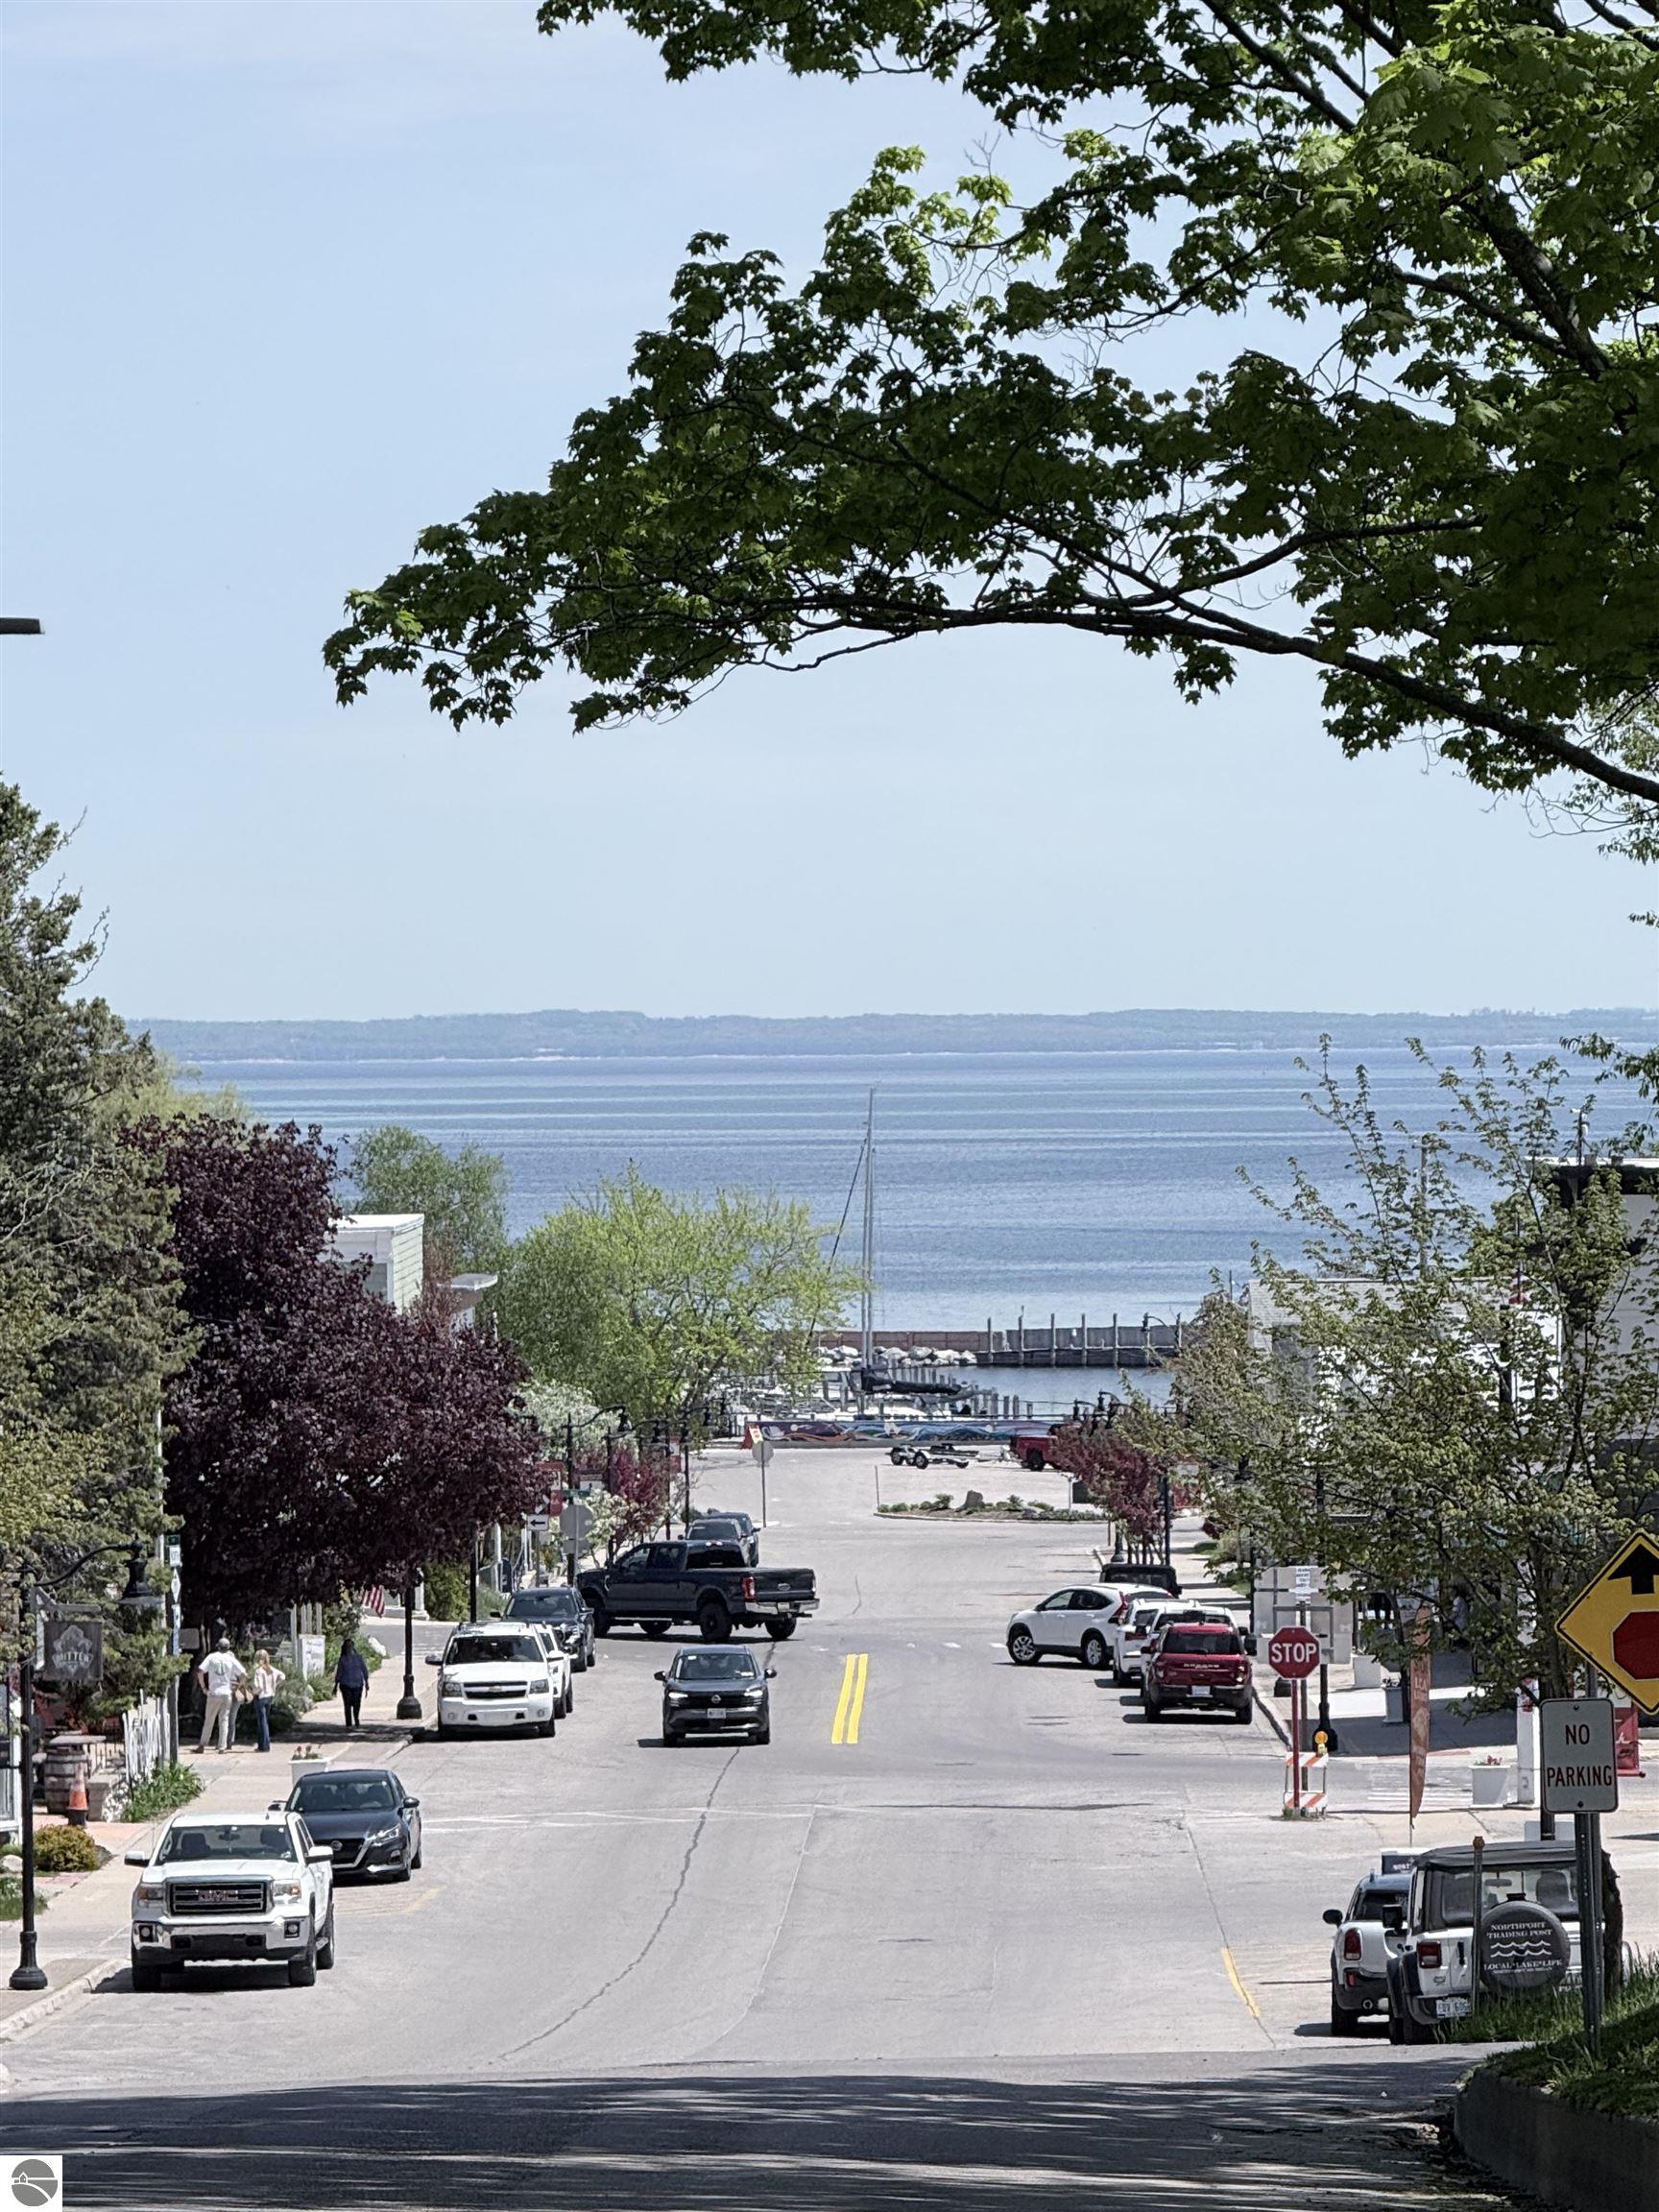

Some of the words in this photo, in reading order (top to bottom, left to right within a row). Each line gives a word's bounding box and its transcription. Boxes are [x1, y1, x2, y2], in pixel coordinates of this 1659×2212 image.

[1271, 1643, 1317, 1664] STOP
[1565, 1724, 1591, 1745] NO
[1547, 1765, 1612, 1788] PARKING
[1486, 1930, 1528, 1939] TRADING
[1529, 1929, 1553, 1937] POST
[1490, 1921, 1547, 1932] NORTHPORT
